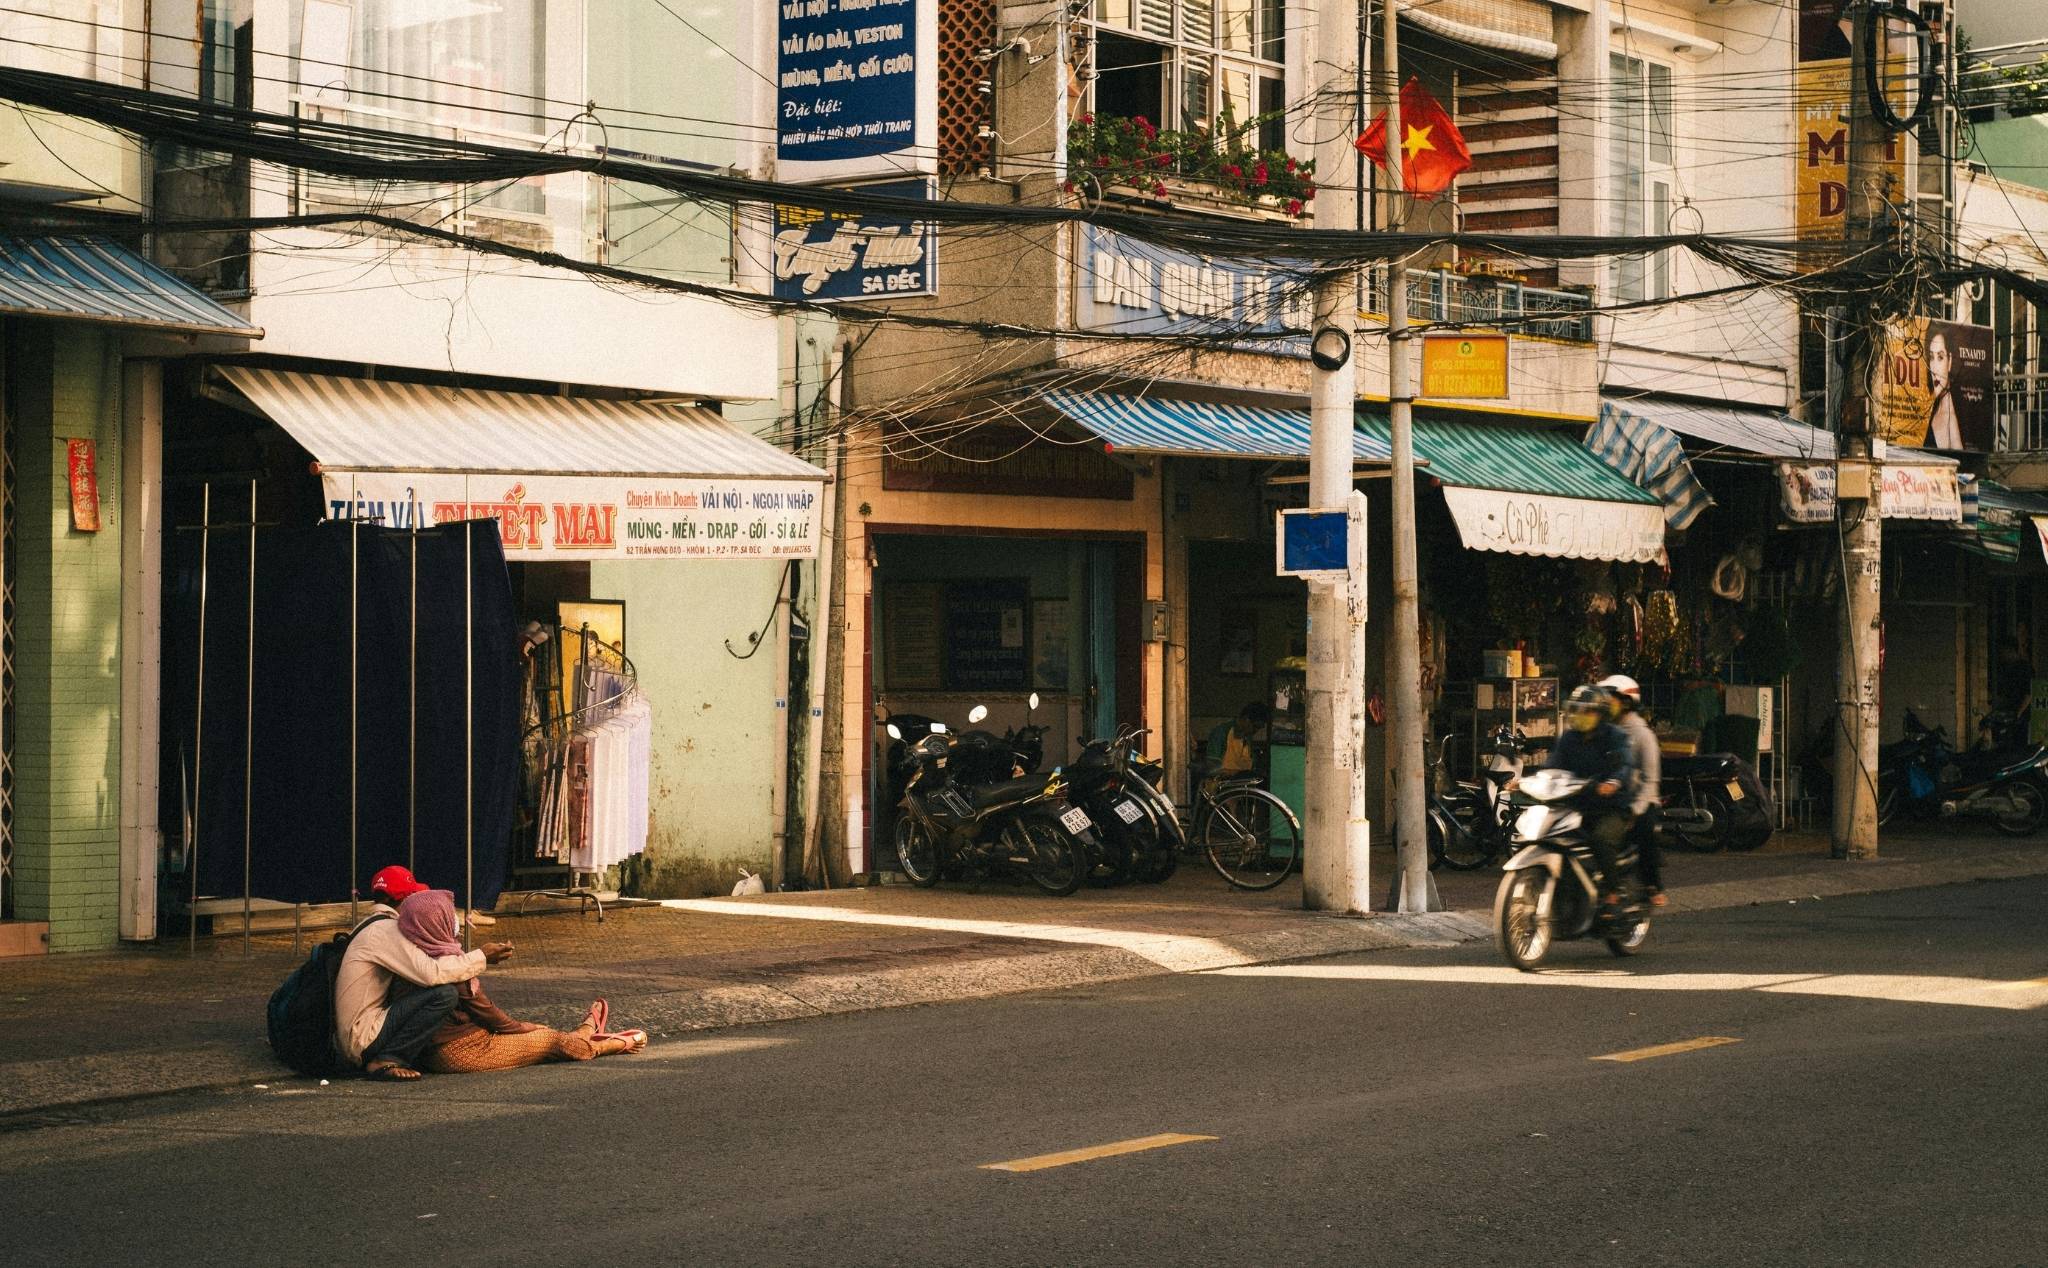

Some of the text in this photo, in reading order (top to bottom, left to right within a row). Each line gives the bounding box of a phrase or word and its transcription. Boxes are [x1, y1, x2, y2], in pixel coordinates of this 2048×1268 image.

[783, 24, 903, 55] VẢI ÁO DÀI, VESTON
[781, 68, 821, 88] MÙNG,
[858, 55, 880, 78] GỐI
[885, 120, 912, 134] TRANG
[862, 276, 884, 294] SA
[1959, 347, 1986, 361] TENAMYD
[626, 490, 653, 510] Chuyên
[655, 490, 672, 506] Kinh
[673, 492, 698, 508] Doanh:
[701, 485, 719, 508] VẢI
[723, 487, 742, 512] NỘI
[752, 493, 784, 512] NGOẠI
[786, 488, 814, 512] NHẬP
[551, 501, 616, 549] MAI
[627, 518, 662, 539] MÙNG
[672, 514, 696, 539] MỀN
[707, 522, 738, 539] DRAP
[750, 512, 766, 539] GỐI
[777, 517, 787, 539] SỈ
[790, 522, 796, 539] &
[798, 514, 810, 538] LẺ
[1506, 500, 1524, 544] Cà
[1525, 502, 1549, 545] Phê
